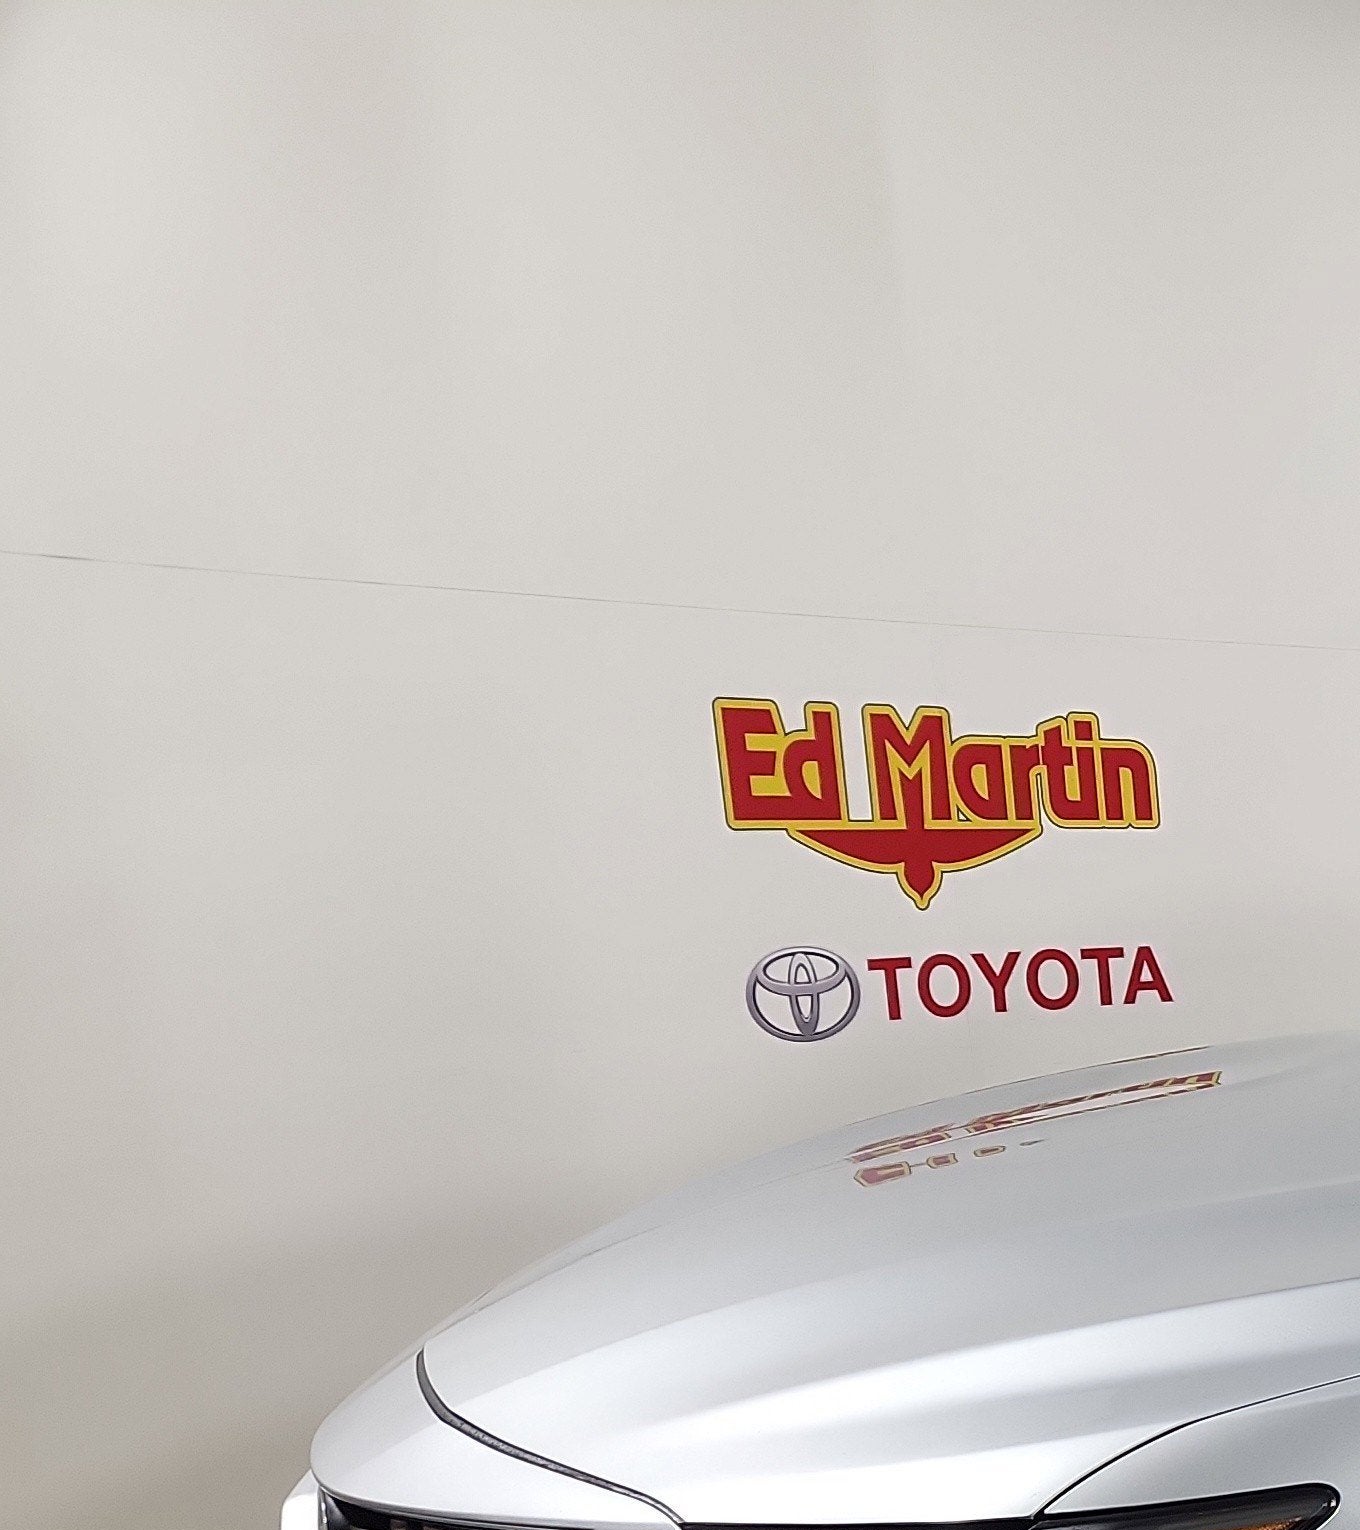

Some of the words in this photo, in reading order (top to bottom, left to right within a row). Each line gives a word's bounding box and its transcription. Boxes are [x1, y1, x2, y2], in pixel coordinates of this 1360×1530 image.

[714, 698, 843, 830] Ed
[862, 704, 1160, 829] Martin
[867, 946, 1173, 1020] TOYOTA
